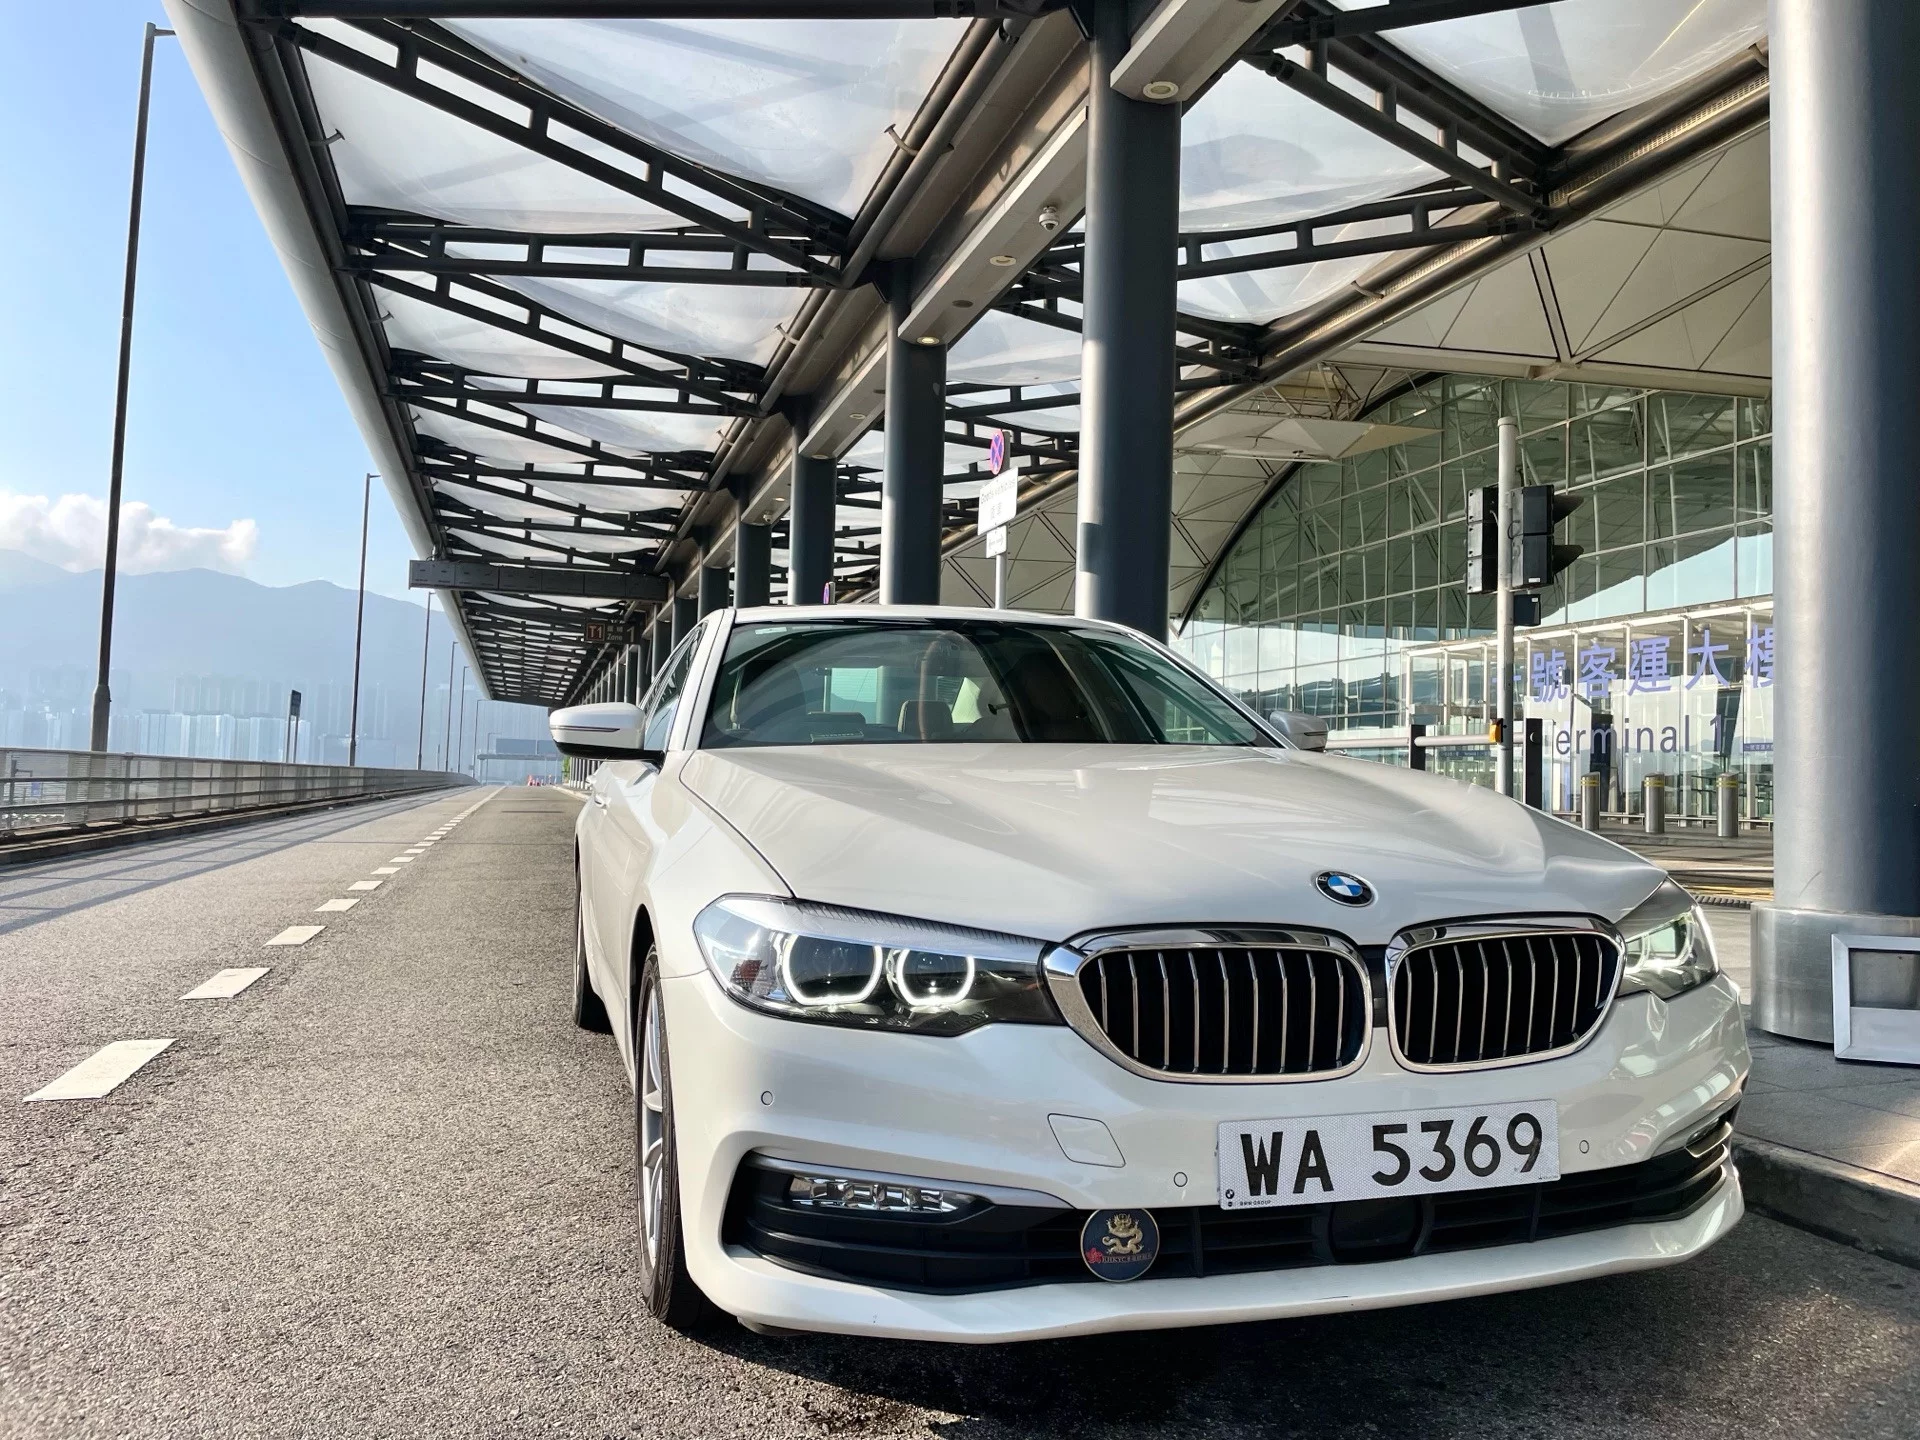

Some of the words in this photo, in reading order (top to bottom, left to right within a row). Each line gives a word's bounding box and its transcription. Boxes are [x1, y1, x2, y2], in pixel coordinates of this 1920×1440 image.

[589, 625, 602, 639] T1
[626, 626, 635, 643] 1
[1555, 714, 1690, 755] erminal
[1709, 714, 1722, 753] 1
[1240, 1130, 1334, 1196] WA
[1371, 1112, 1543, 1186] 5369
